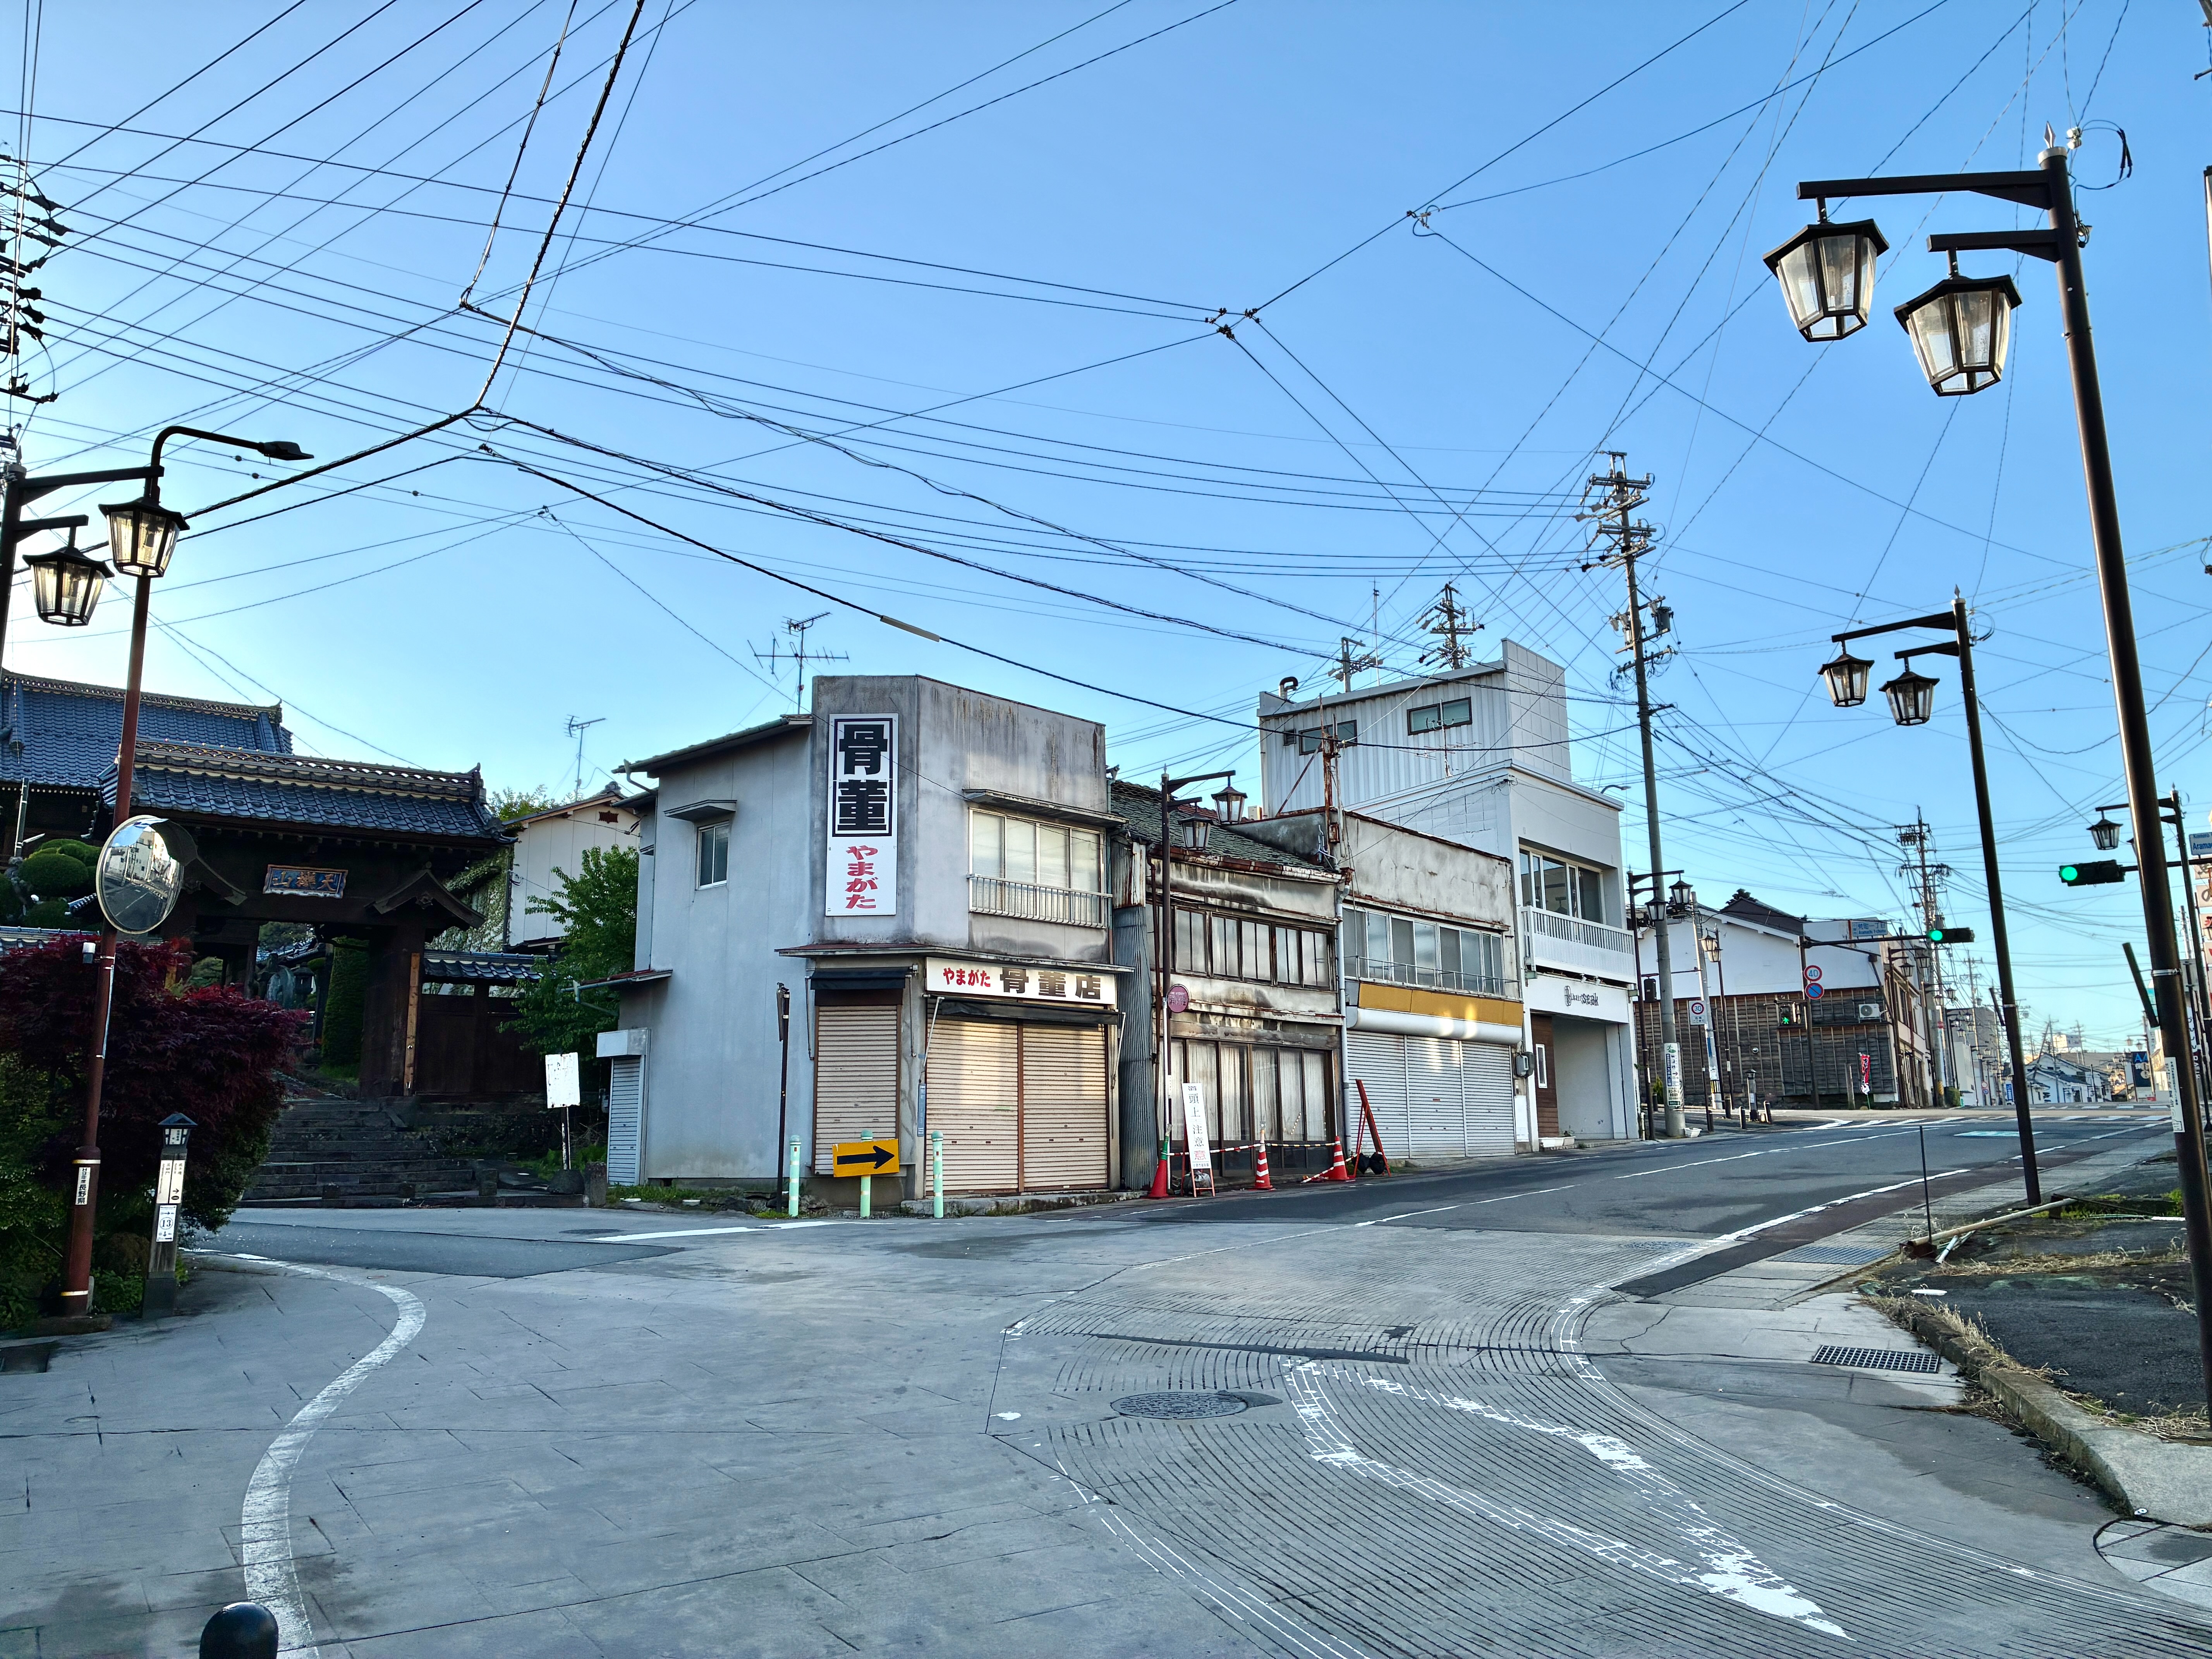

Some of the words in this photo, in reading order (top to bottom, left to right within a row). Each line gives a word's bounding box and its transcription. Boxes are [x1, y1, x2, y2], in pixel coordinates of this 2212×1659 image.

[837, 724, 888, 831] 骨董
[845, 845, 879, 910] やまがた
[943, 967, 991, 988] やまがた
[1000, 967, 1102, 1000] 骨董店
[1188, 1093, 1204, 1147] 頭上注意
[162, 1219, 171, 1228] 13
